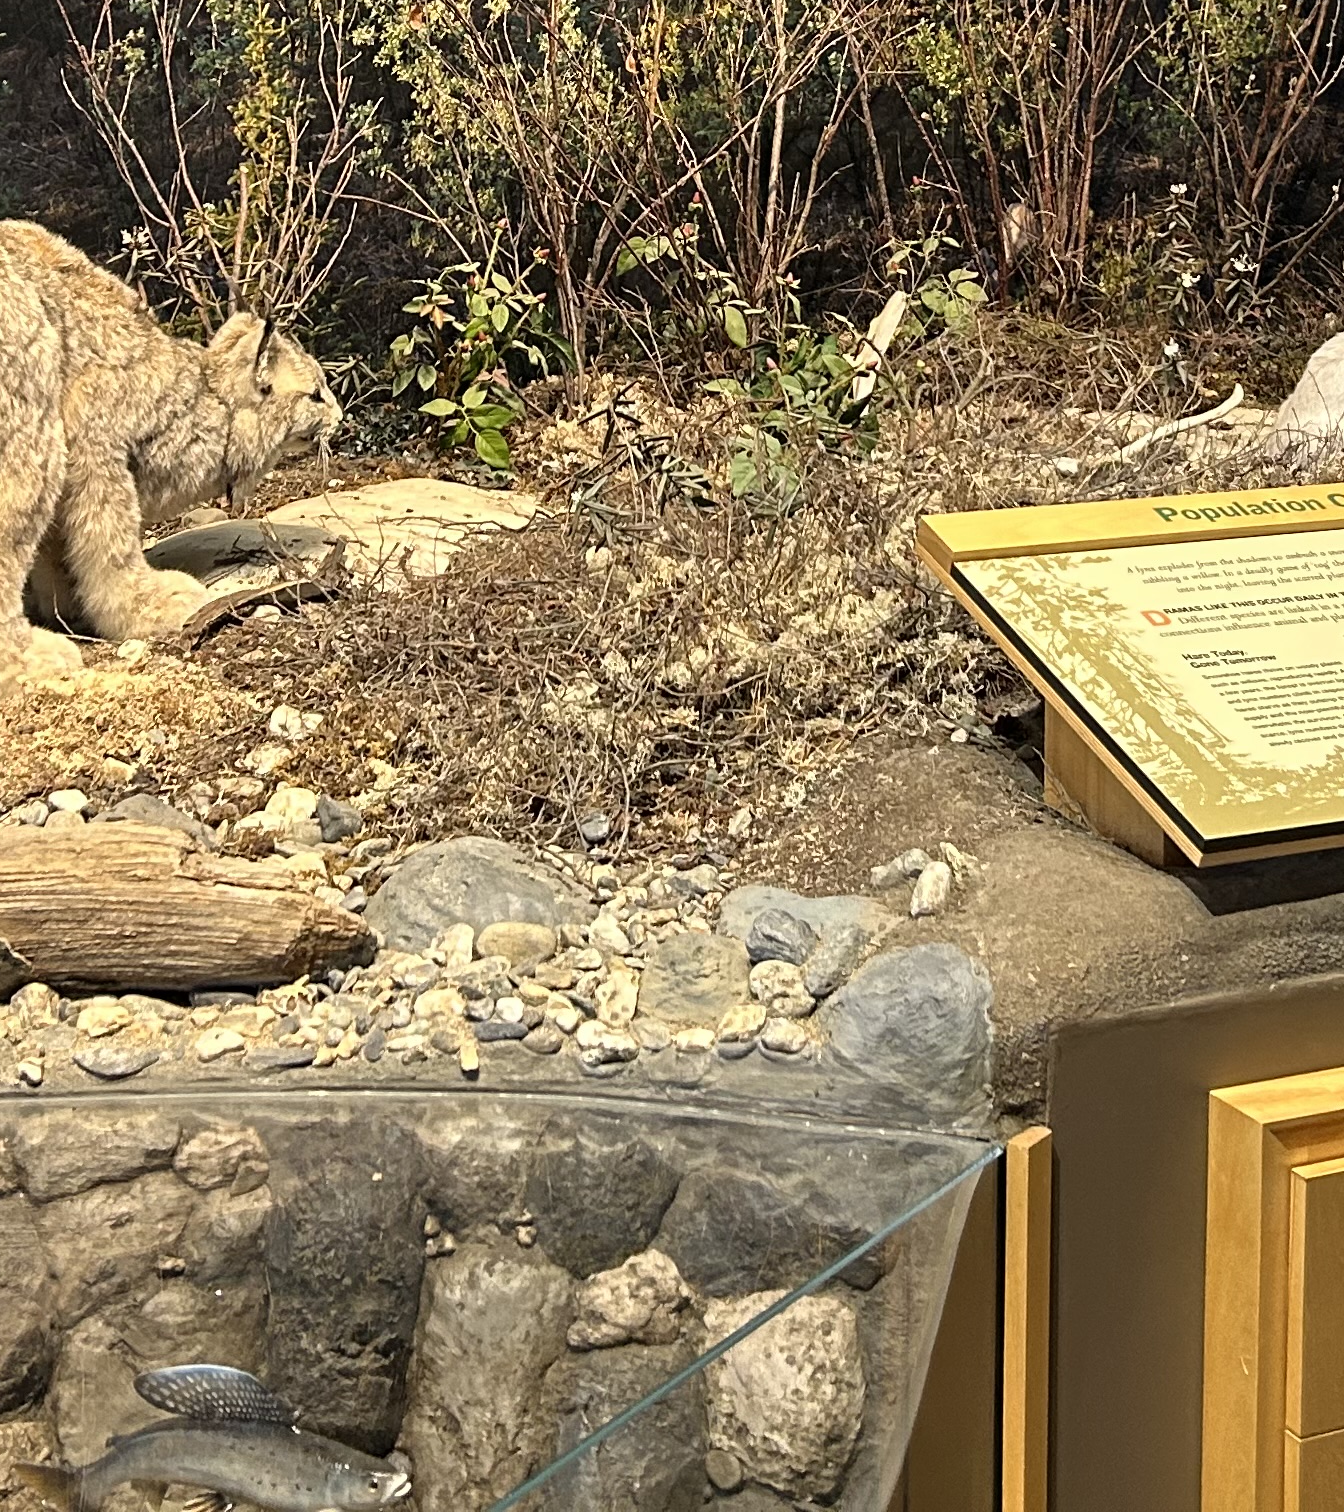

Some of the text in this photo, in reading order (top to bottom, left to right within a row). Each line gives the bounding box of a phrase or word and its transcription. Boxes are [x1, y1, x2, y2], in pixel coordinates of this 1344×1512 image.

[1153, 498, 1327, 522] Population
[1195, 560, 1218, 569] from
[1229, 599, 1257, 608] THIS
[1256, 596, 1294, 606] OCCUR
[1294, 593, 1324, 603] DAILY
[1177, 613, 1228, 625] Different
[1230, 610, 1266, 621] species
[1159, 626, 1222, 638] connections
[1222, 621, 1271, 631] influence
[1220, 655, 1276, 665] Tomorrow
